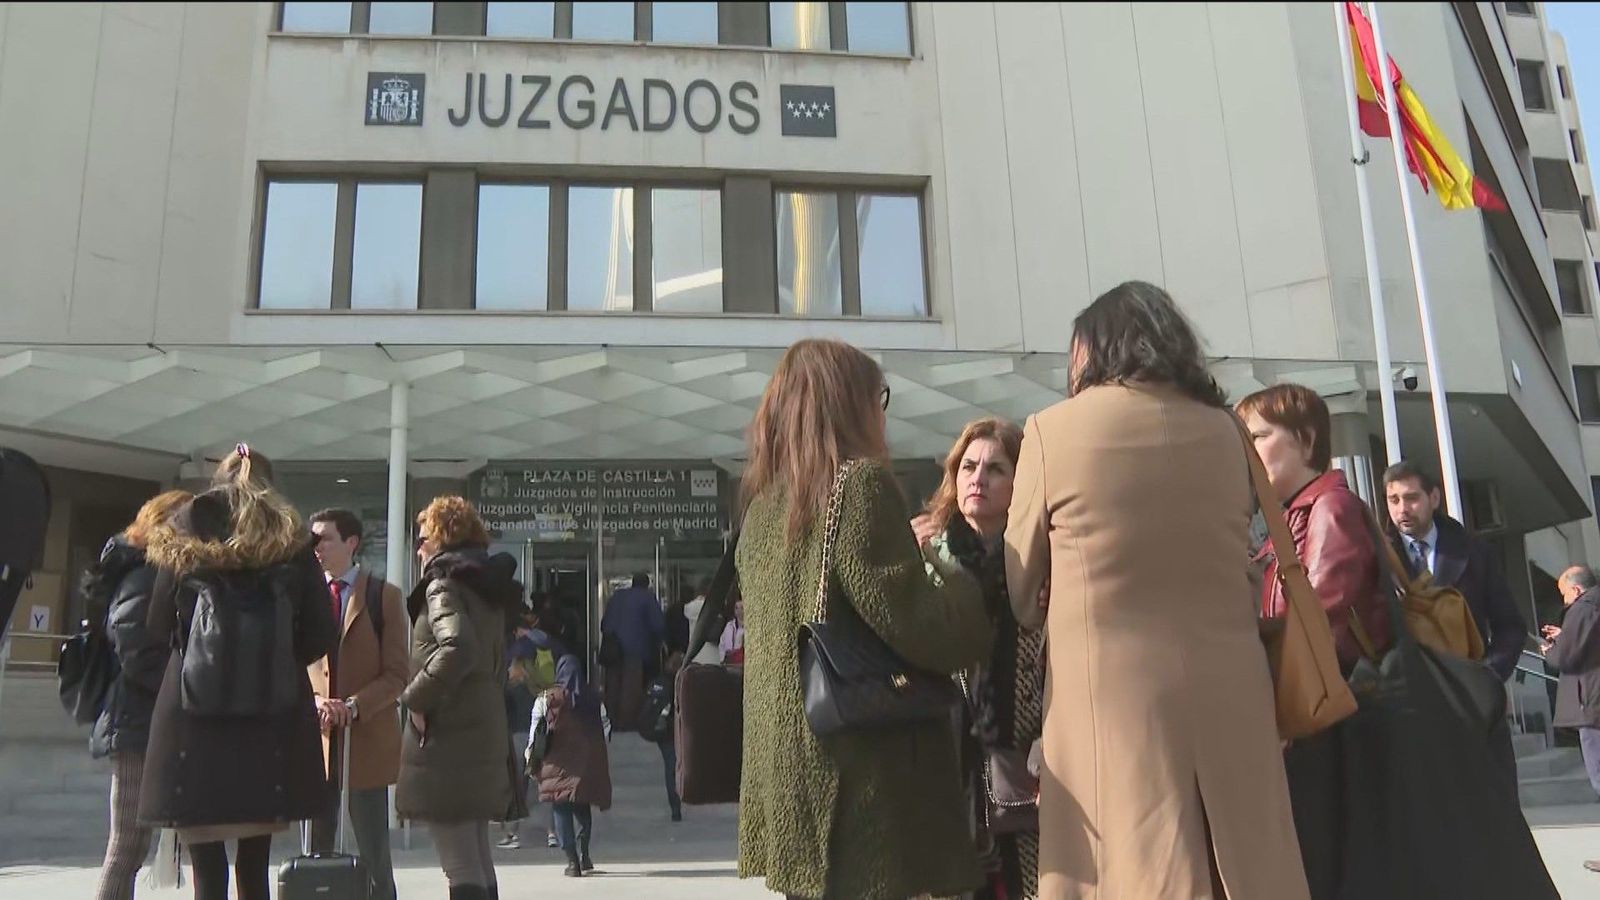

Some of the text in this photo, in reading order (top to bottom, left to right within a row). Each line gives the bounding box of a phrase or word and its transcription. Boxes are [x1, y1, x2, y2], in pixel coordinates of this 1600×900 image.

[447, 72, 762, 135] JUZGADOS
[523, 470, 685, 483] PLAZA DE CASTILLA 1
[514, 486, 676, 500] Juzgados de Instrucción
[477, 502, 717, 516] Juzgados de Vigilancia Penitenciaria
[484, 518, 718, 532] ecanato de los Juzgados de Madrid
[34, 614, 44, 628] Y
